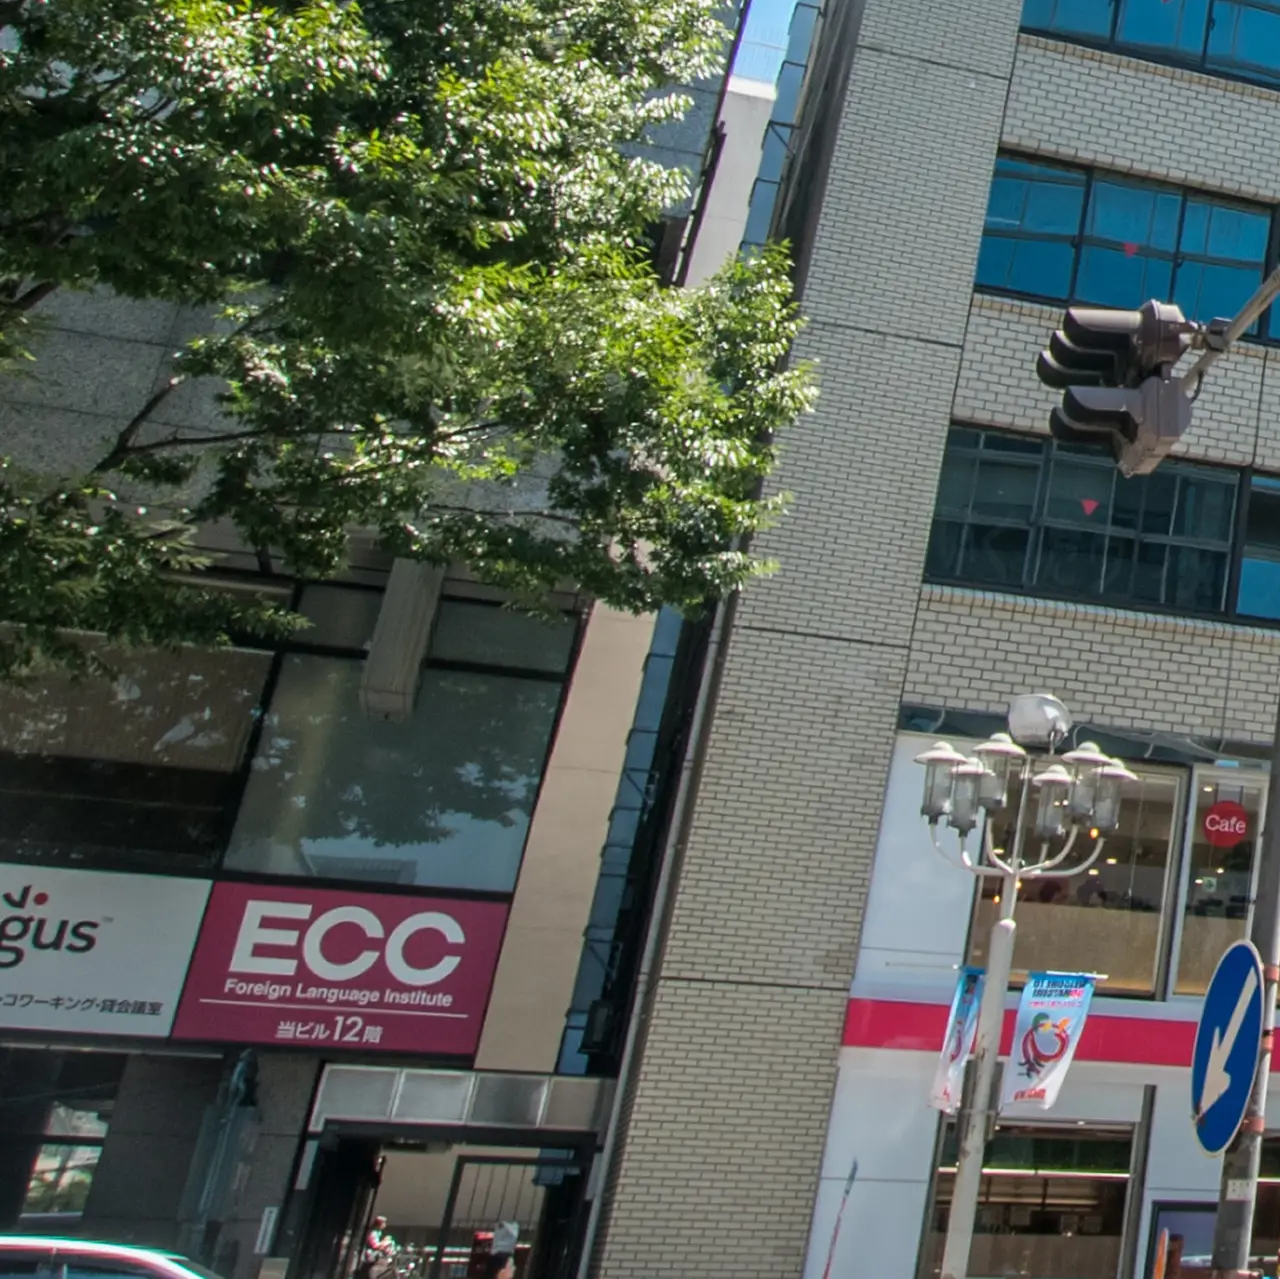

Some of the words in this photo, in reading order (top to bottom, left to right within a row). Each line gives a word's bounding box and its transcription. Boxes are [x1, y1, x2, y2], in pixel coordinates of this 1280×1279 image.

[1205, 814, 1246, 834] Cafe
[228, 899, 467, 987] ECC
[223, 977, 292, 999] Foreign
[295, 982, 380, 1007] Language
[383, 988, 454, 1008] Institute
[274, 1014, 384, 1045] 当ビル12階
